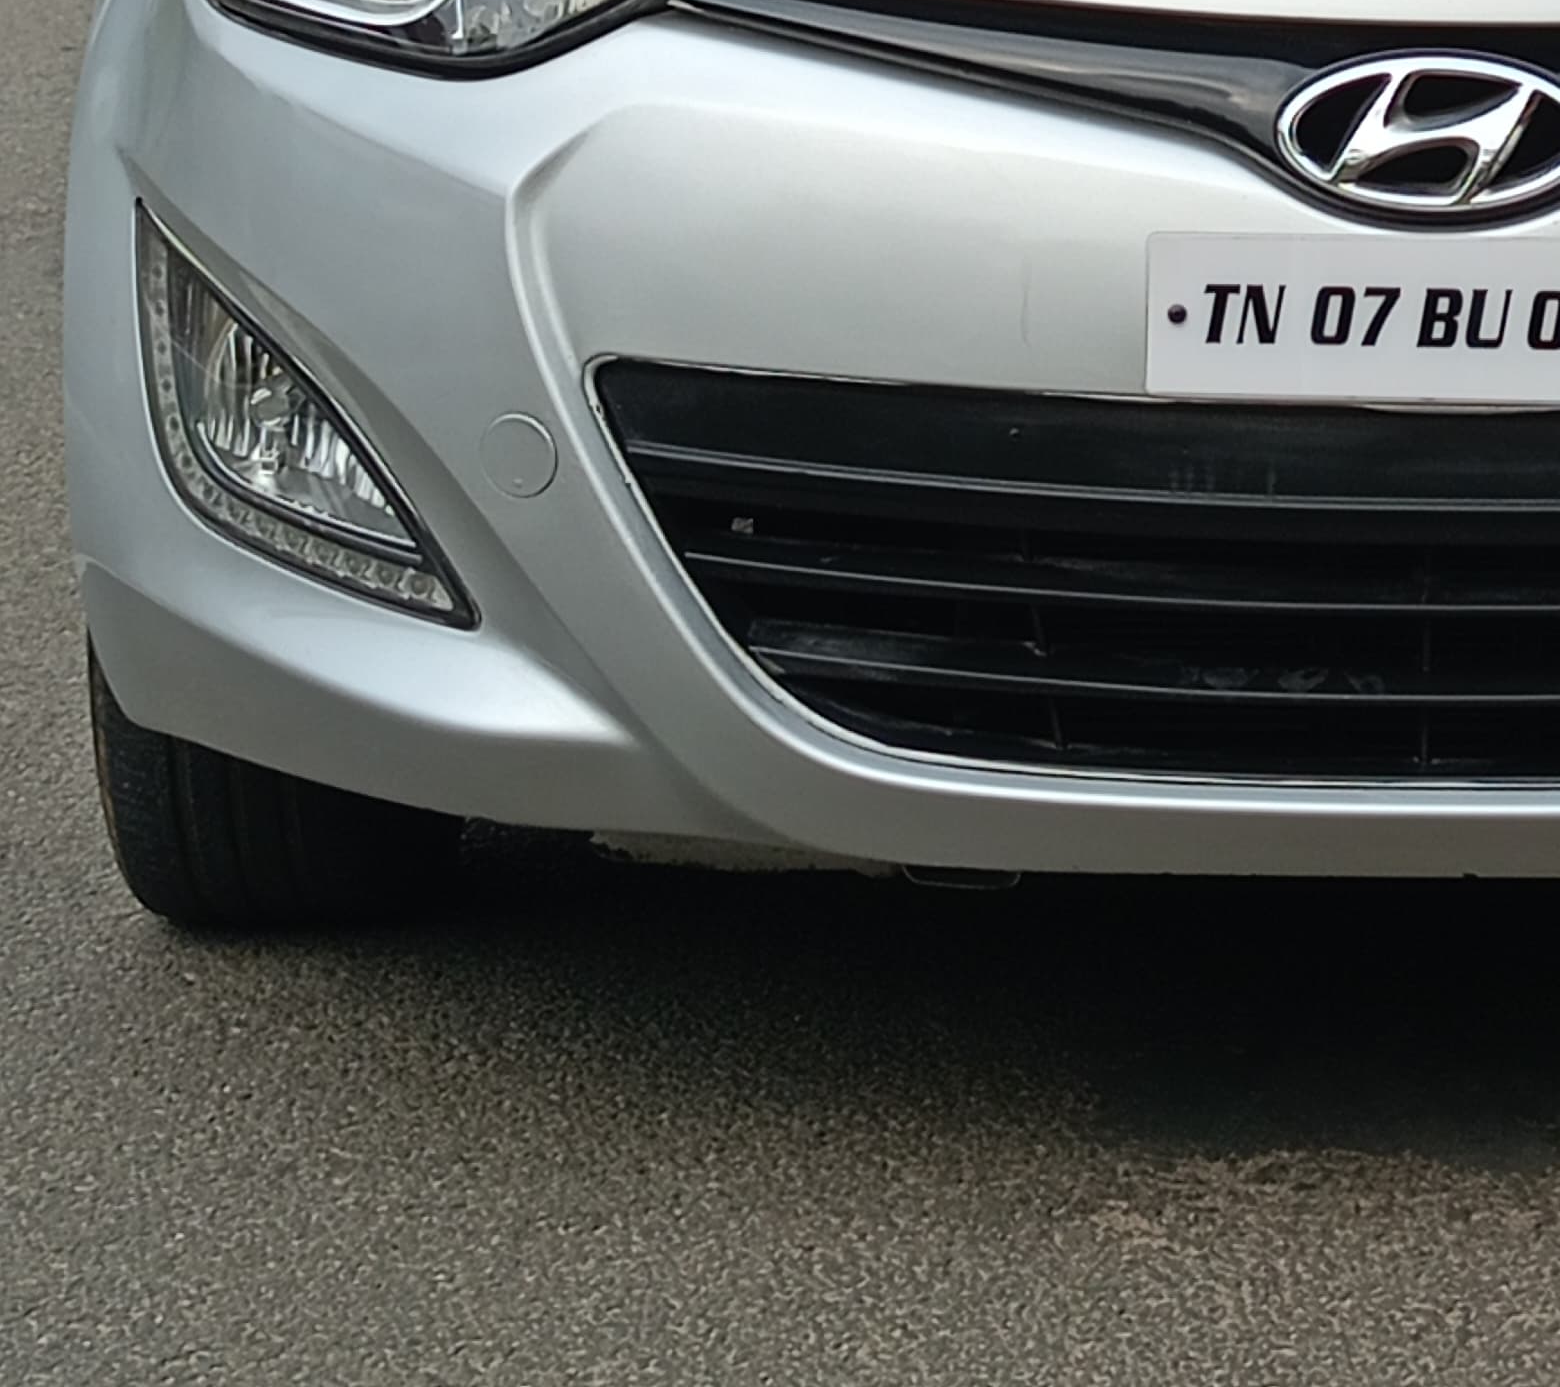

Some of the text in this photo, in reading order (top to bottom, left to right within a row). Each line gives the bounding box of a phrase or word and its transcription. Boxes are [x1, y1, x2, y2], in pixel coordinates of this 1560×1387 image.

[1204, 283, 1286, 345] TN
[1310, 286, 1402, 347] 07
[1416, 287, 1514, 349] BU
